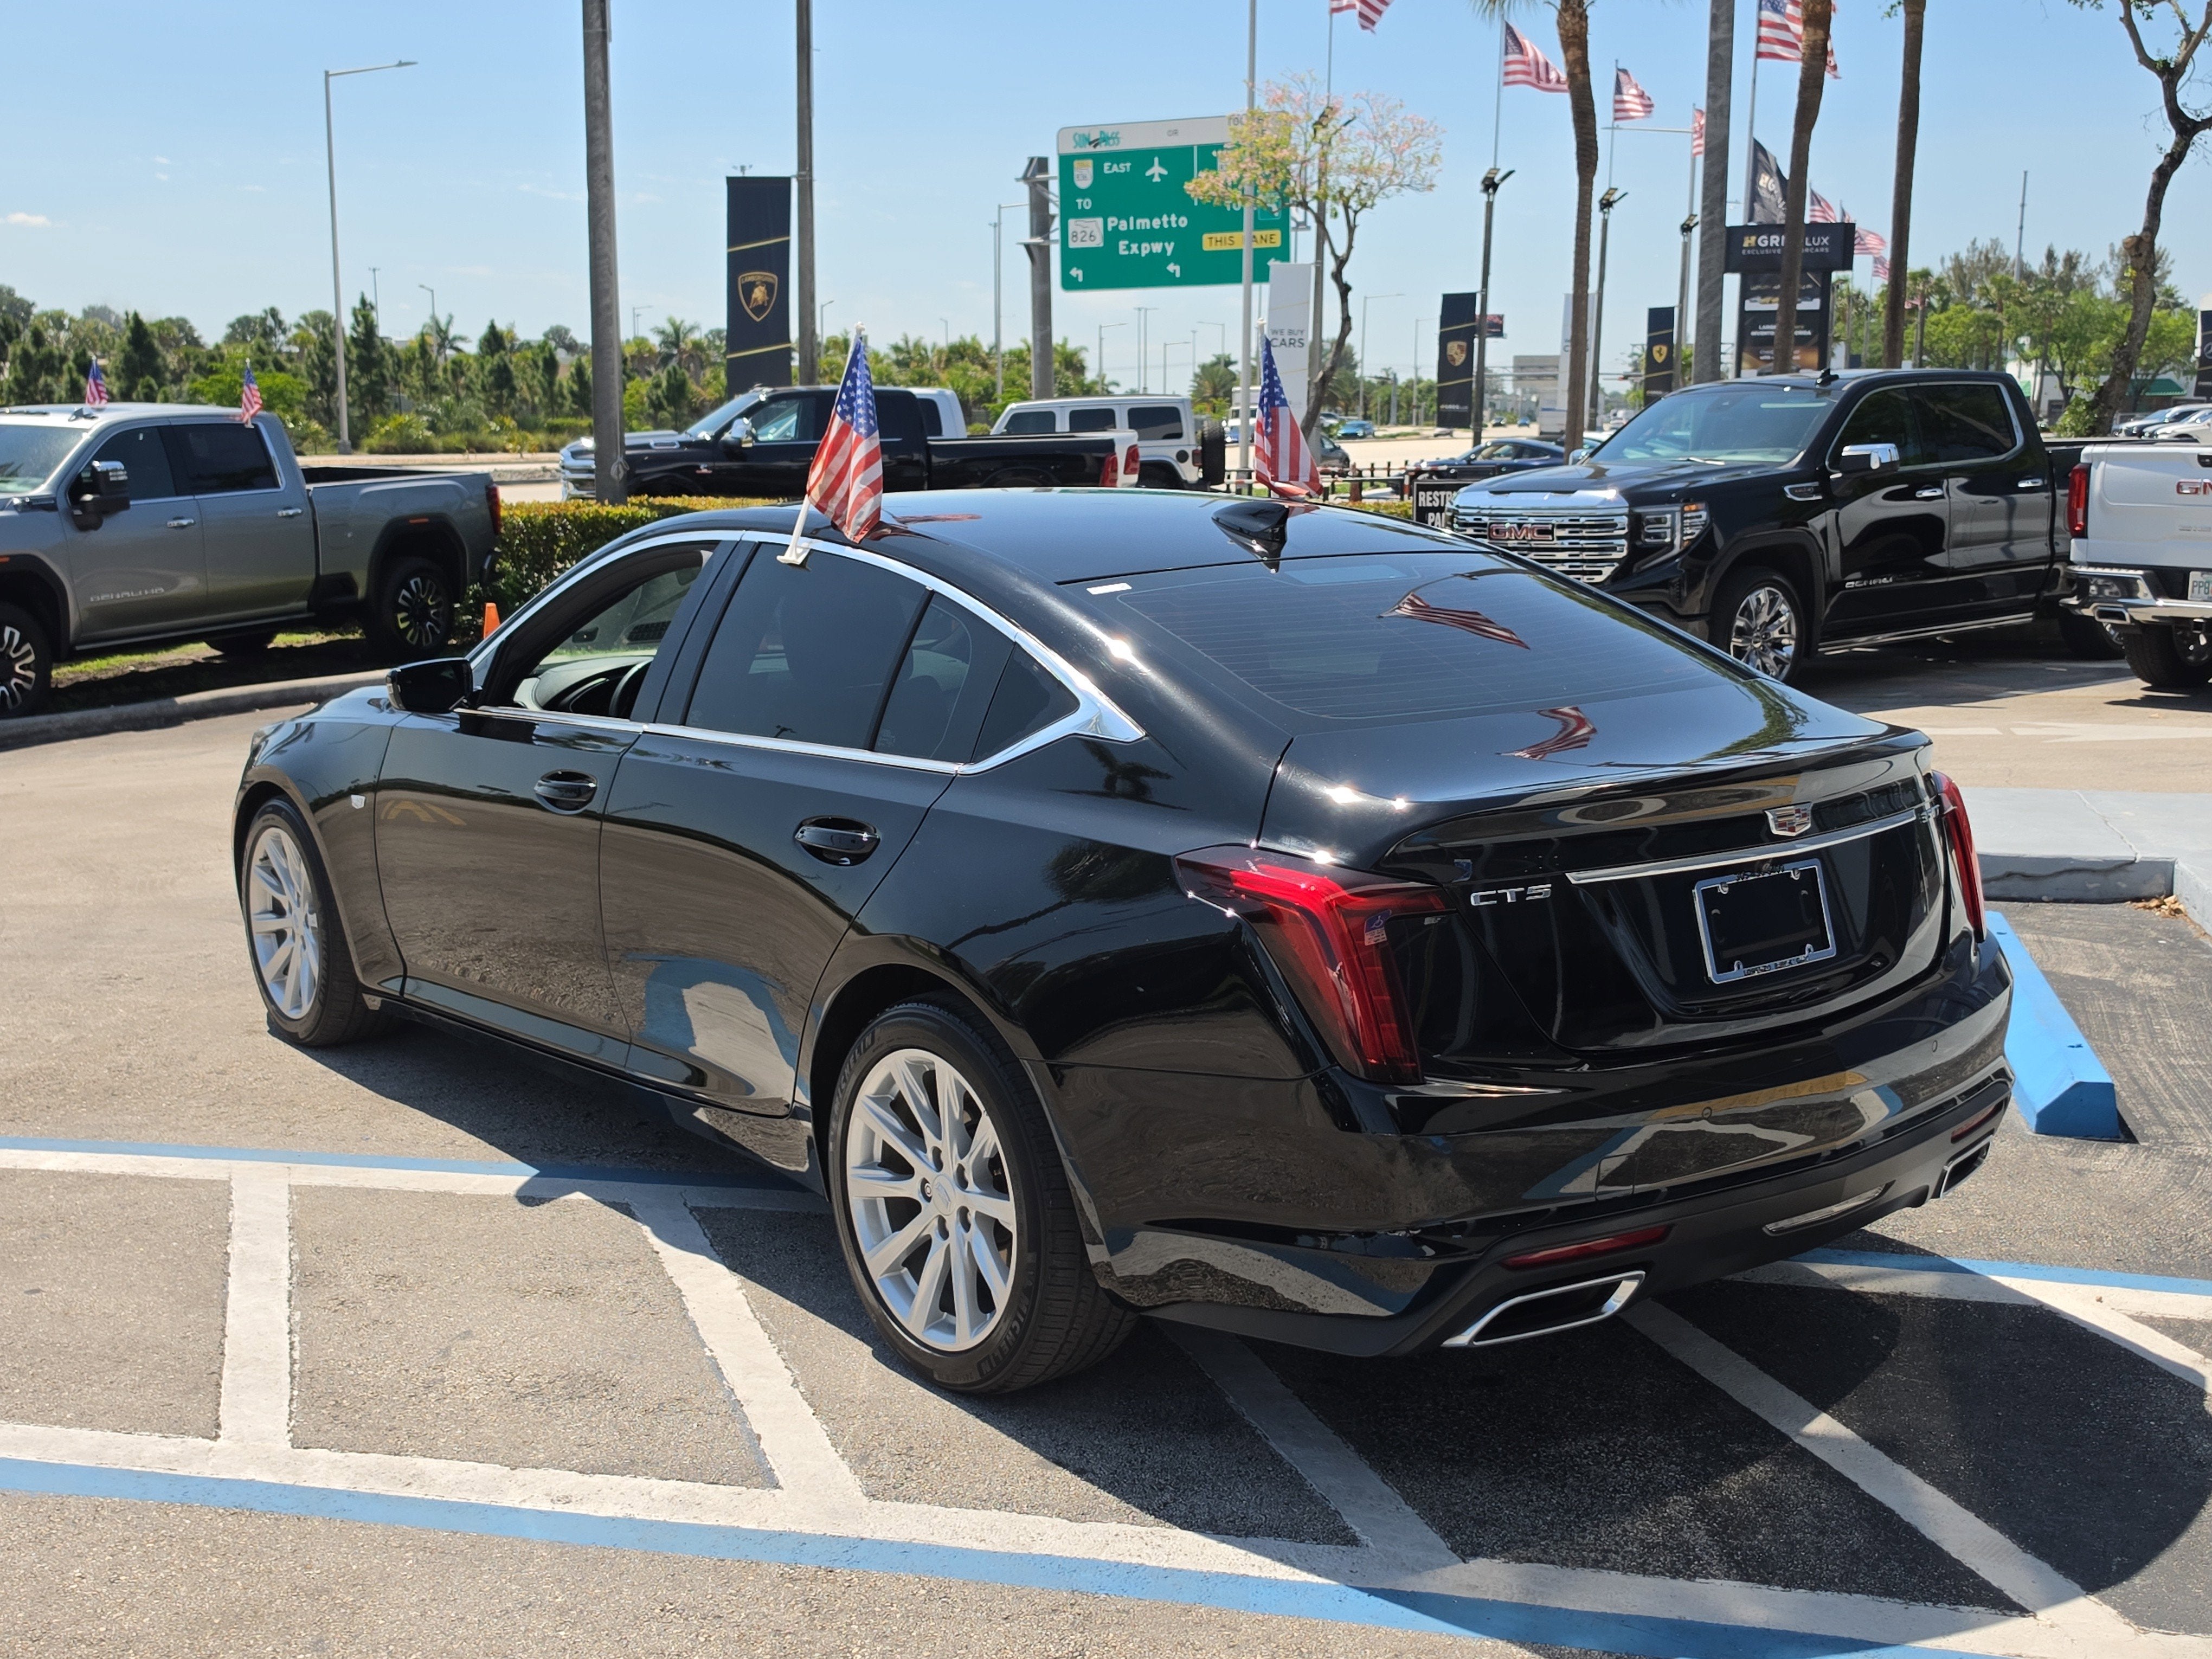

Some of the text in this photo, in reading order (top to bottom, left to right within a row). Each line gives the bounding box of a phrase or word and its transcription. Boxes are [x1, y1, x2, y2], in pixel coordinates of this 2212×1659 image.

[1103, 162, 1131, 174] EAST
[1075, 197, 1092, 210] TO
[1107, 213, 1188, 232] Palmetto
[1070, 230, 1097, 243] 826
[1207, 236, 1236, 247] THIS
[1118, 240, 1175, 257] Expwy
[1271, 338, 1305, 348] CARS
[1490, 523, 1553, 540] GMC
[1845, 576, 1893, 589] DENALI
[1470, 884, 1552, 906] CT5
[980, 1293, 1030, 1377] MICHELIN
